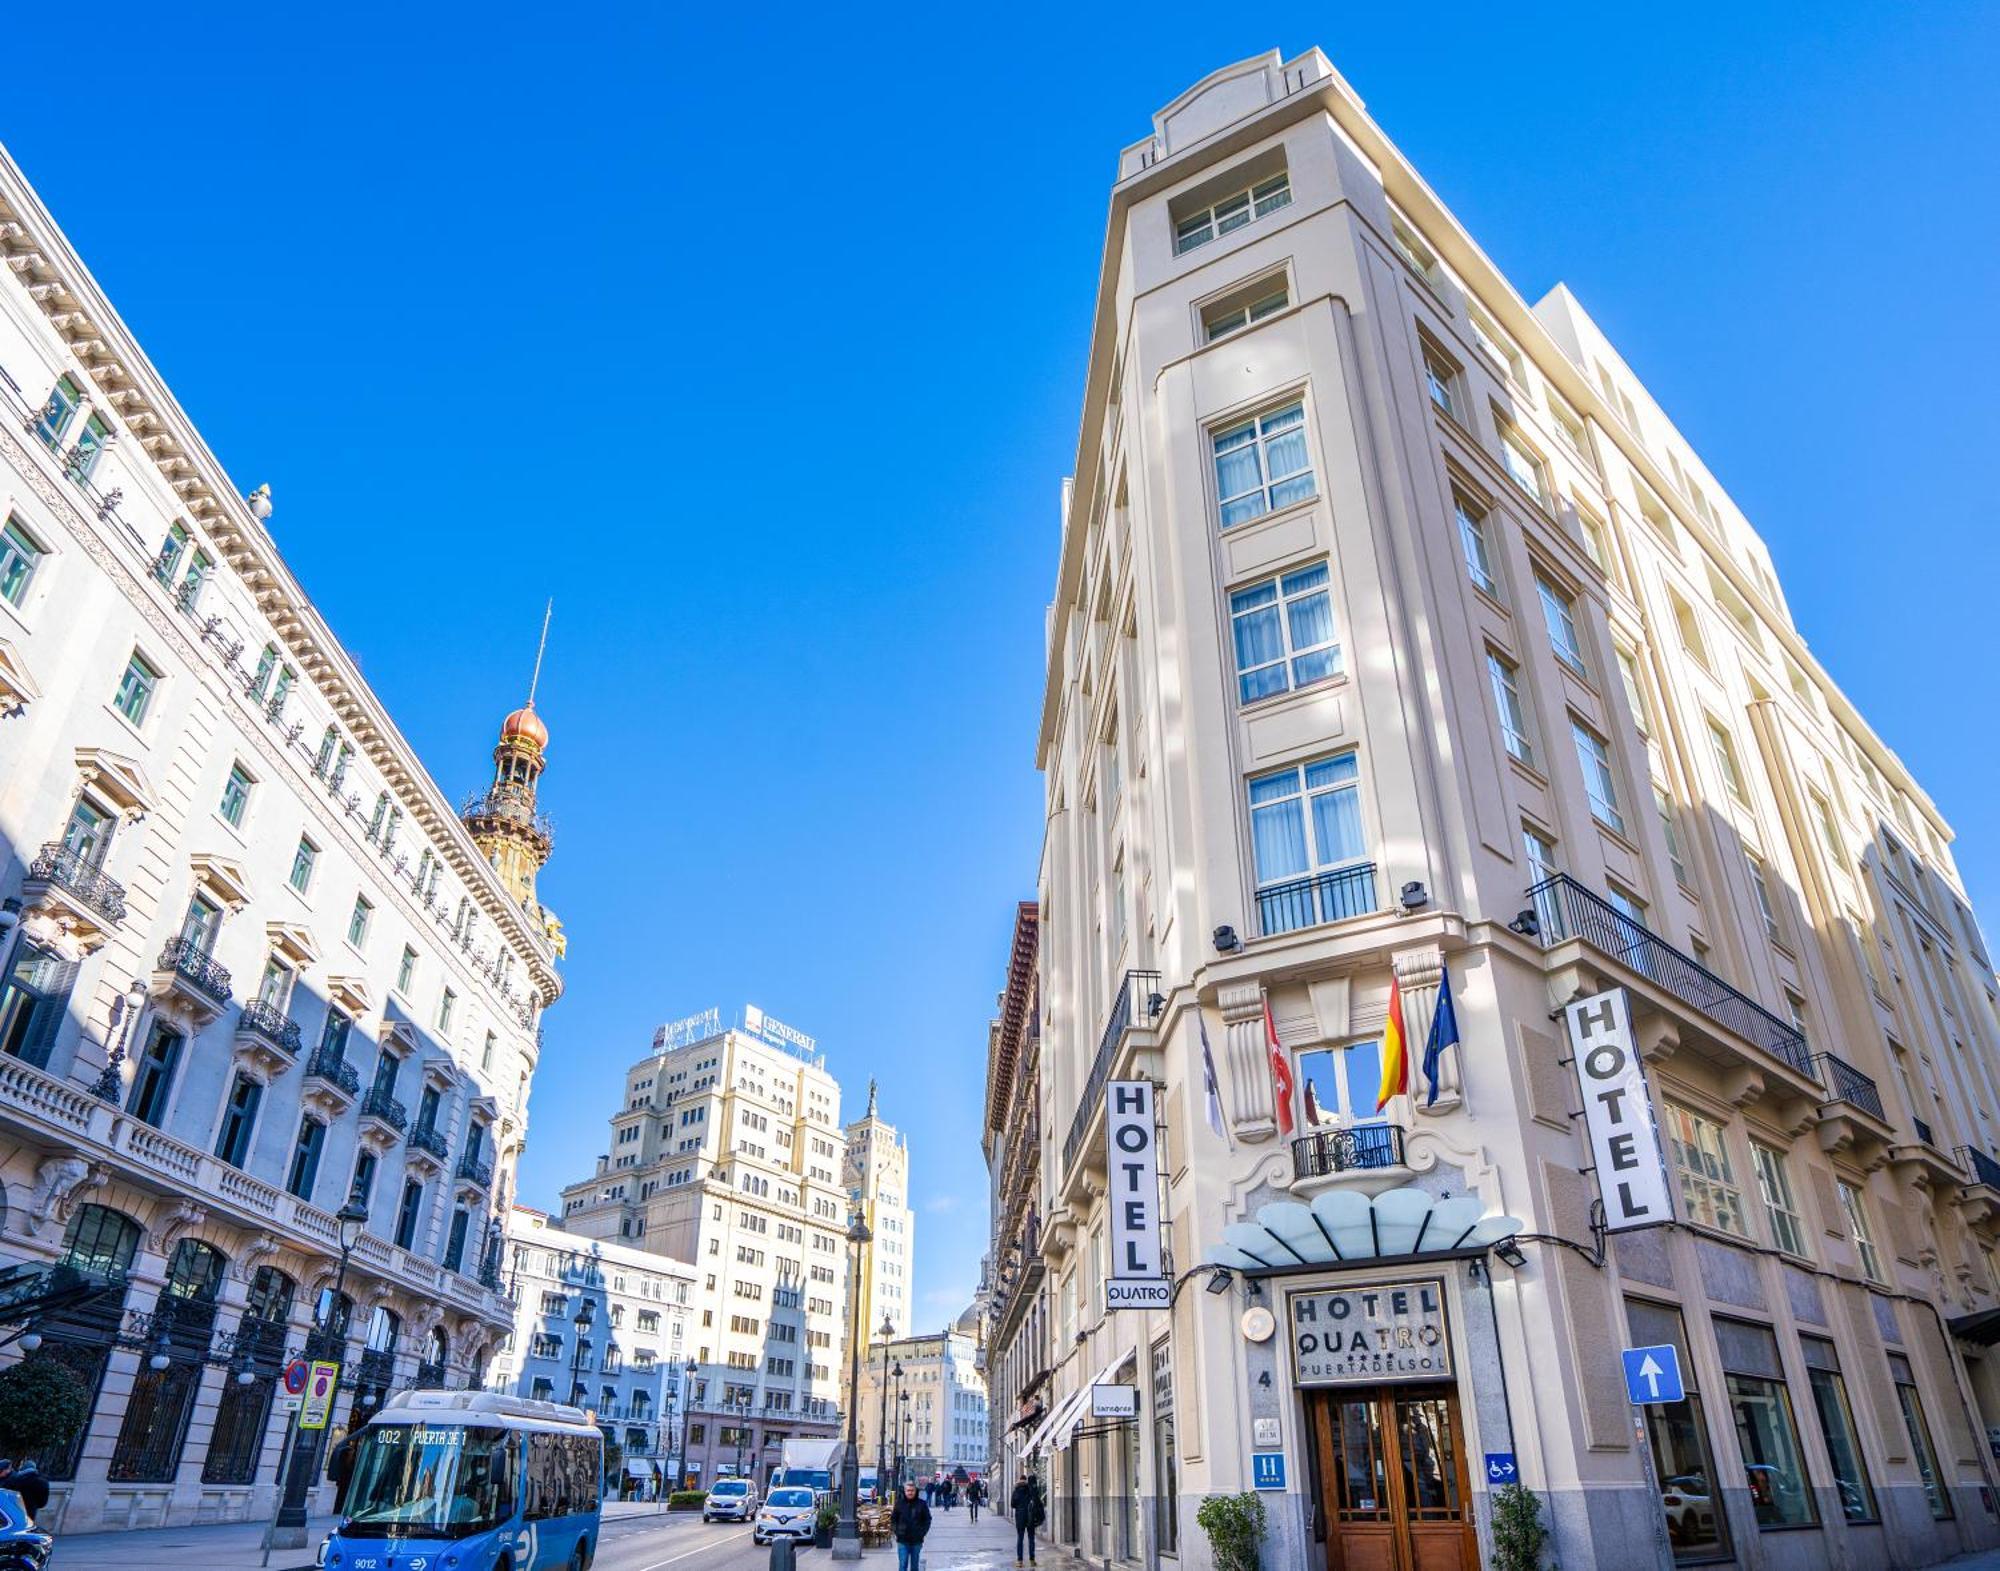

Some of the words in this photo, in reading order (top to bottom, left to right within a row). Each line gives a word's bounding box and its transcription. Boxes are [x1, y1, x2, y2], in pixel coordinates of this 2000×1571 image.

[1577, 999, 1649, 1218] HOTEL
[1116, 1087, 1149, 1271] HOTEL
[1108, 1287, 1169, 1301] QUATRO
[1295, 1290, 1438, 1322] HOTEL
[1298, 1325, 1441, 1356] QUATRO
[1258, 1370, 1272, 1388] 4
[378, 1430, 400, 1444] 002
[1262, 1457, 1276, 1476] H
[354, 1558, 377, 1569] 9012
